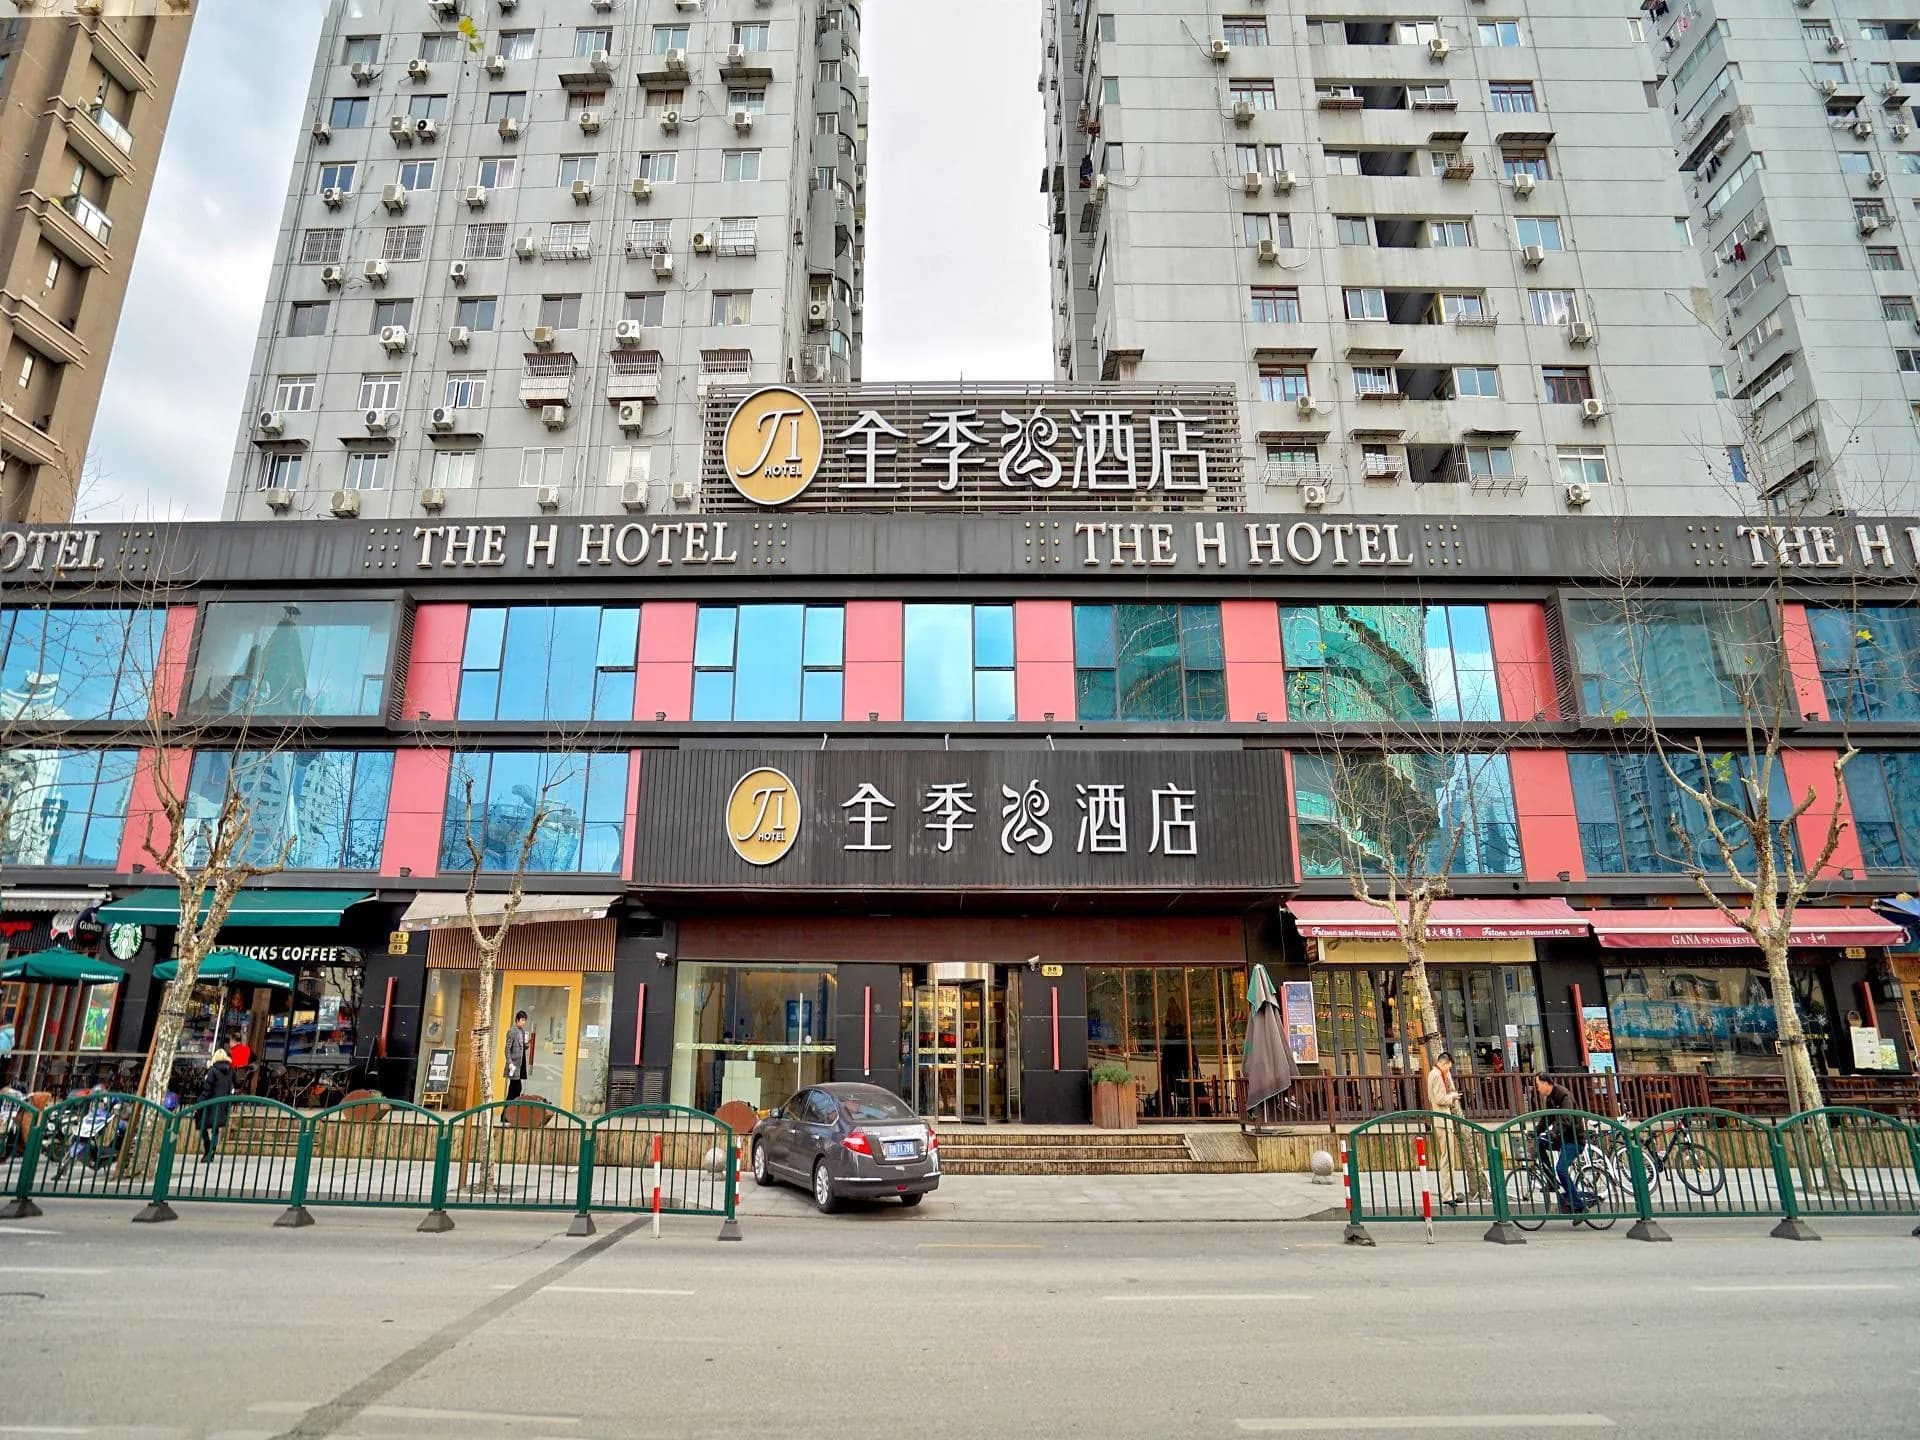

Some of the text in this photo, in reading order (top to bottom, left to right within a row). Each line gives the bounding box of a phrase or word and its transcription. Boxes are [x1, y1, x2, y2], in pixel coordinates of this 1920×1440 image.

[764, 465, 803, 477] HOTEL
[413, 522, 737, 568] THE H HOTEL
[1075, 522, 1414, 566] THE H HOTEL
[1736, 524, 1844, 568] THE
[1854, 524, 1895, 568] H
[758, 832, 786, 842] HOTEL
[1671, 934, 1701, 945] GANA
[281, 946, 338, 961] COFFEE
